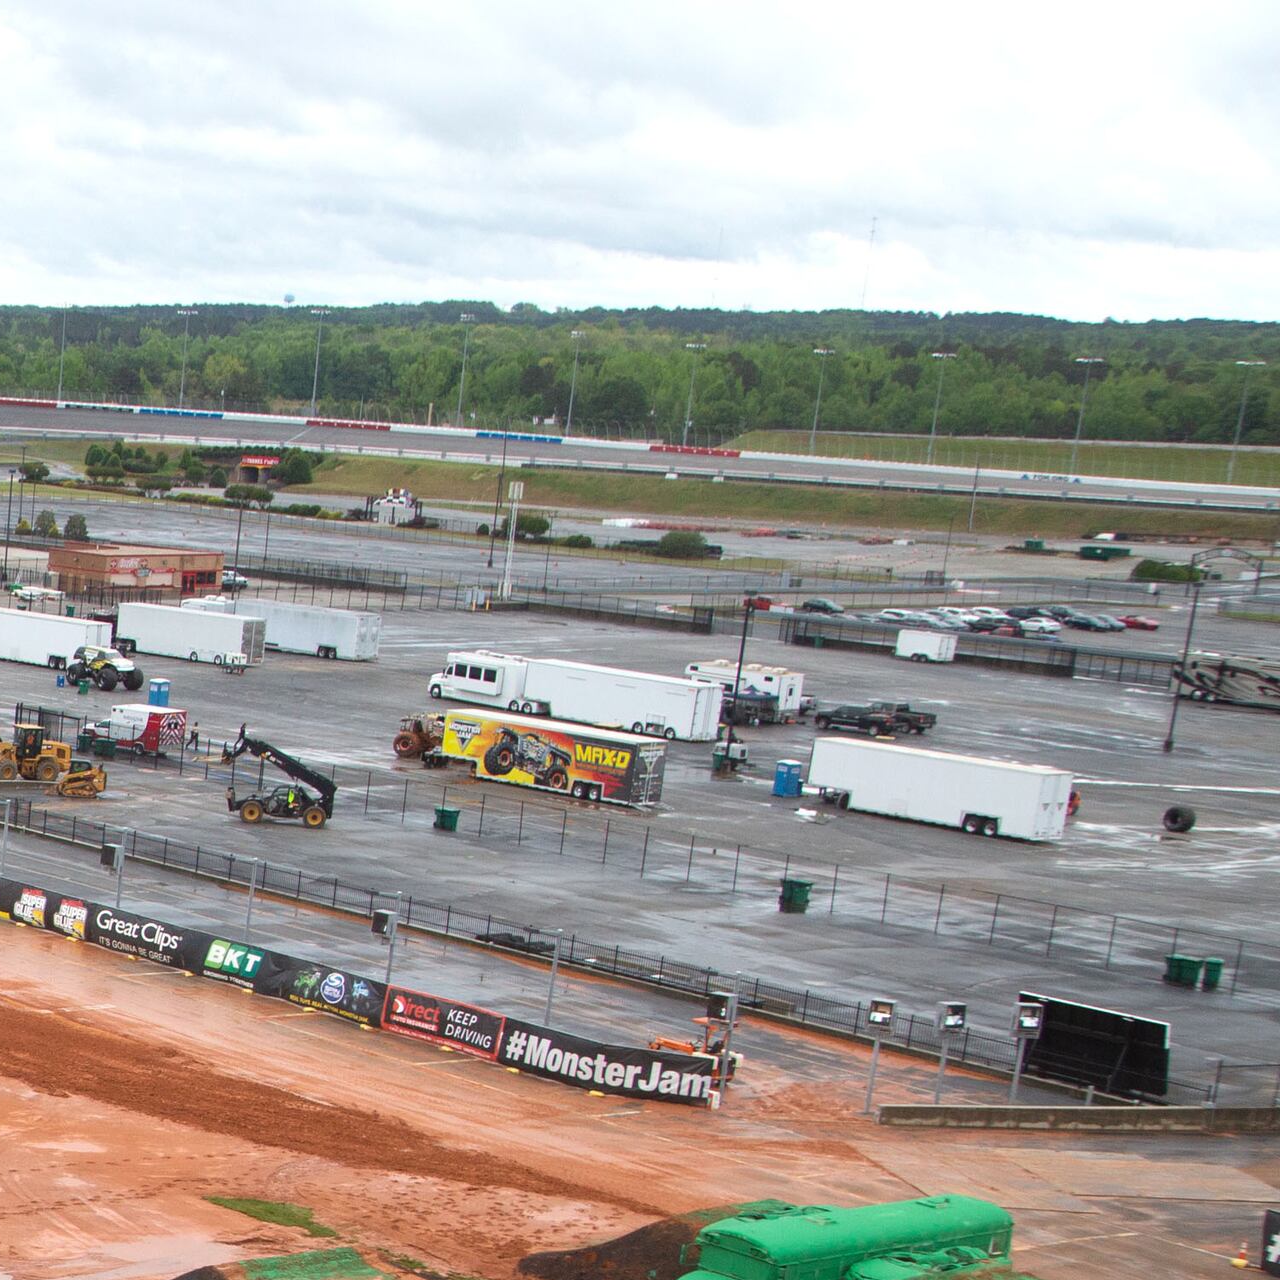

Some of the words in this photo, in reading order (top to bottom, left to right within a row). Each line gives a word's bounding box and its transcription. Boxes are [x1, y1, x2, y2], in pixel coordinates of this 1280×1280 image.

[14, 901, 34, 918] GLUE
[20, 894, 46, 910] SUPER
[54, 912, 74, 930] GLUE
[60, 905, 88, 921] SUPER
[96, 910, 140, 938] Great
[141, 922, 180, 951] Clips
[98, 936, 110, 947] IT'S
[112, 939, 138, 954] GONNA
[138, 948, 148, 957] BE
[148, 950, 172, 964] GREAT
[207, 943, 262, 972] BKT
[447, 1009, 478, 1026] KEEP
[444, 1024, 492, 1048] DRIVING
[506, 1030, 713, 1098] #MonsterJam
